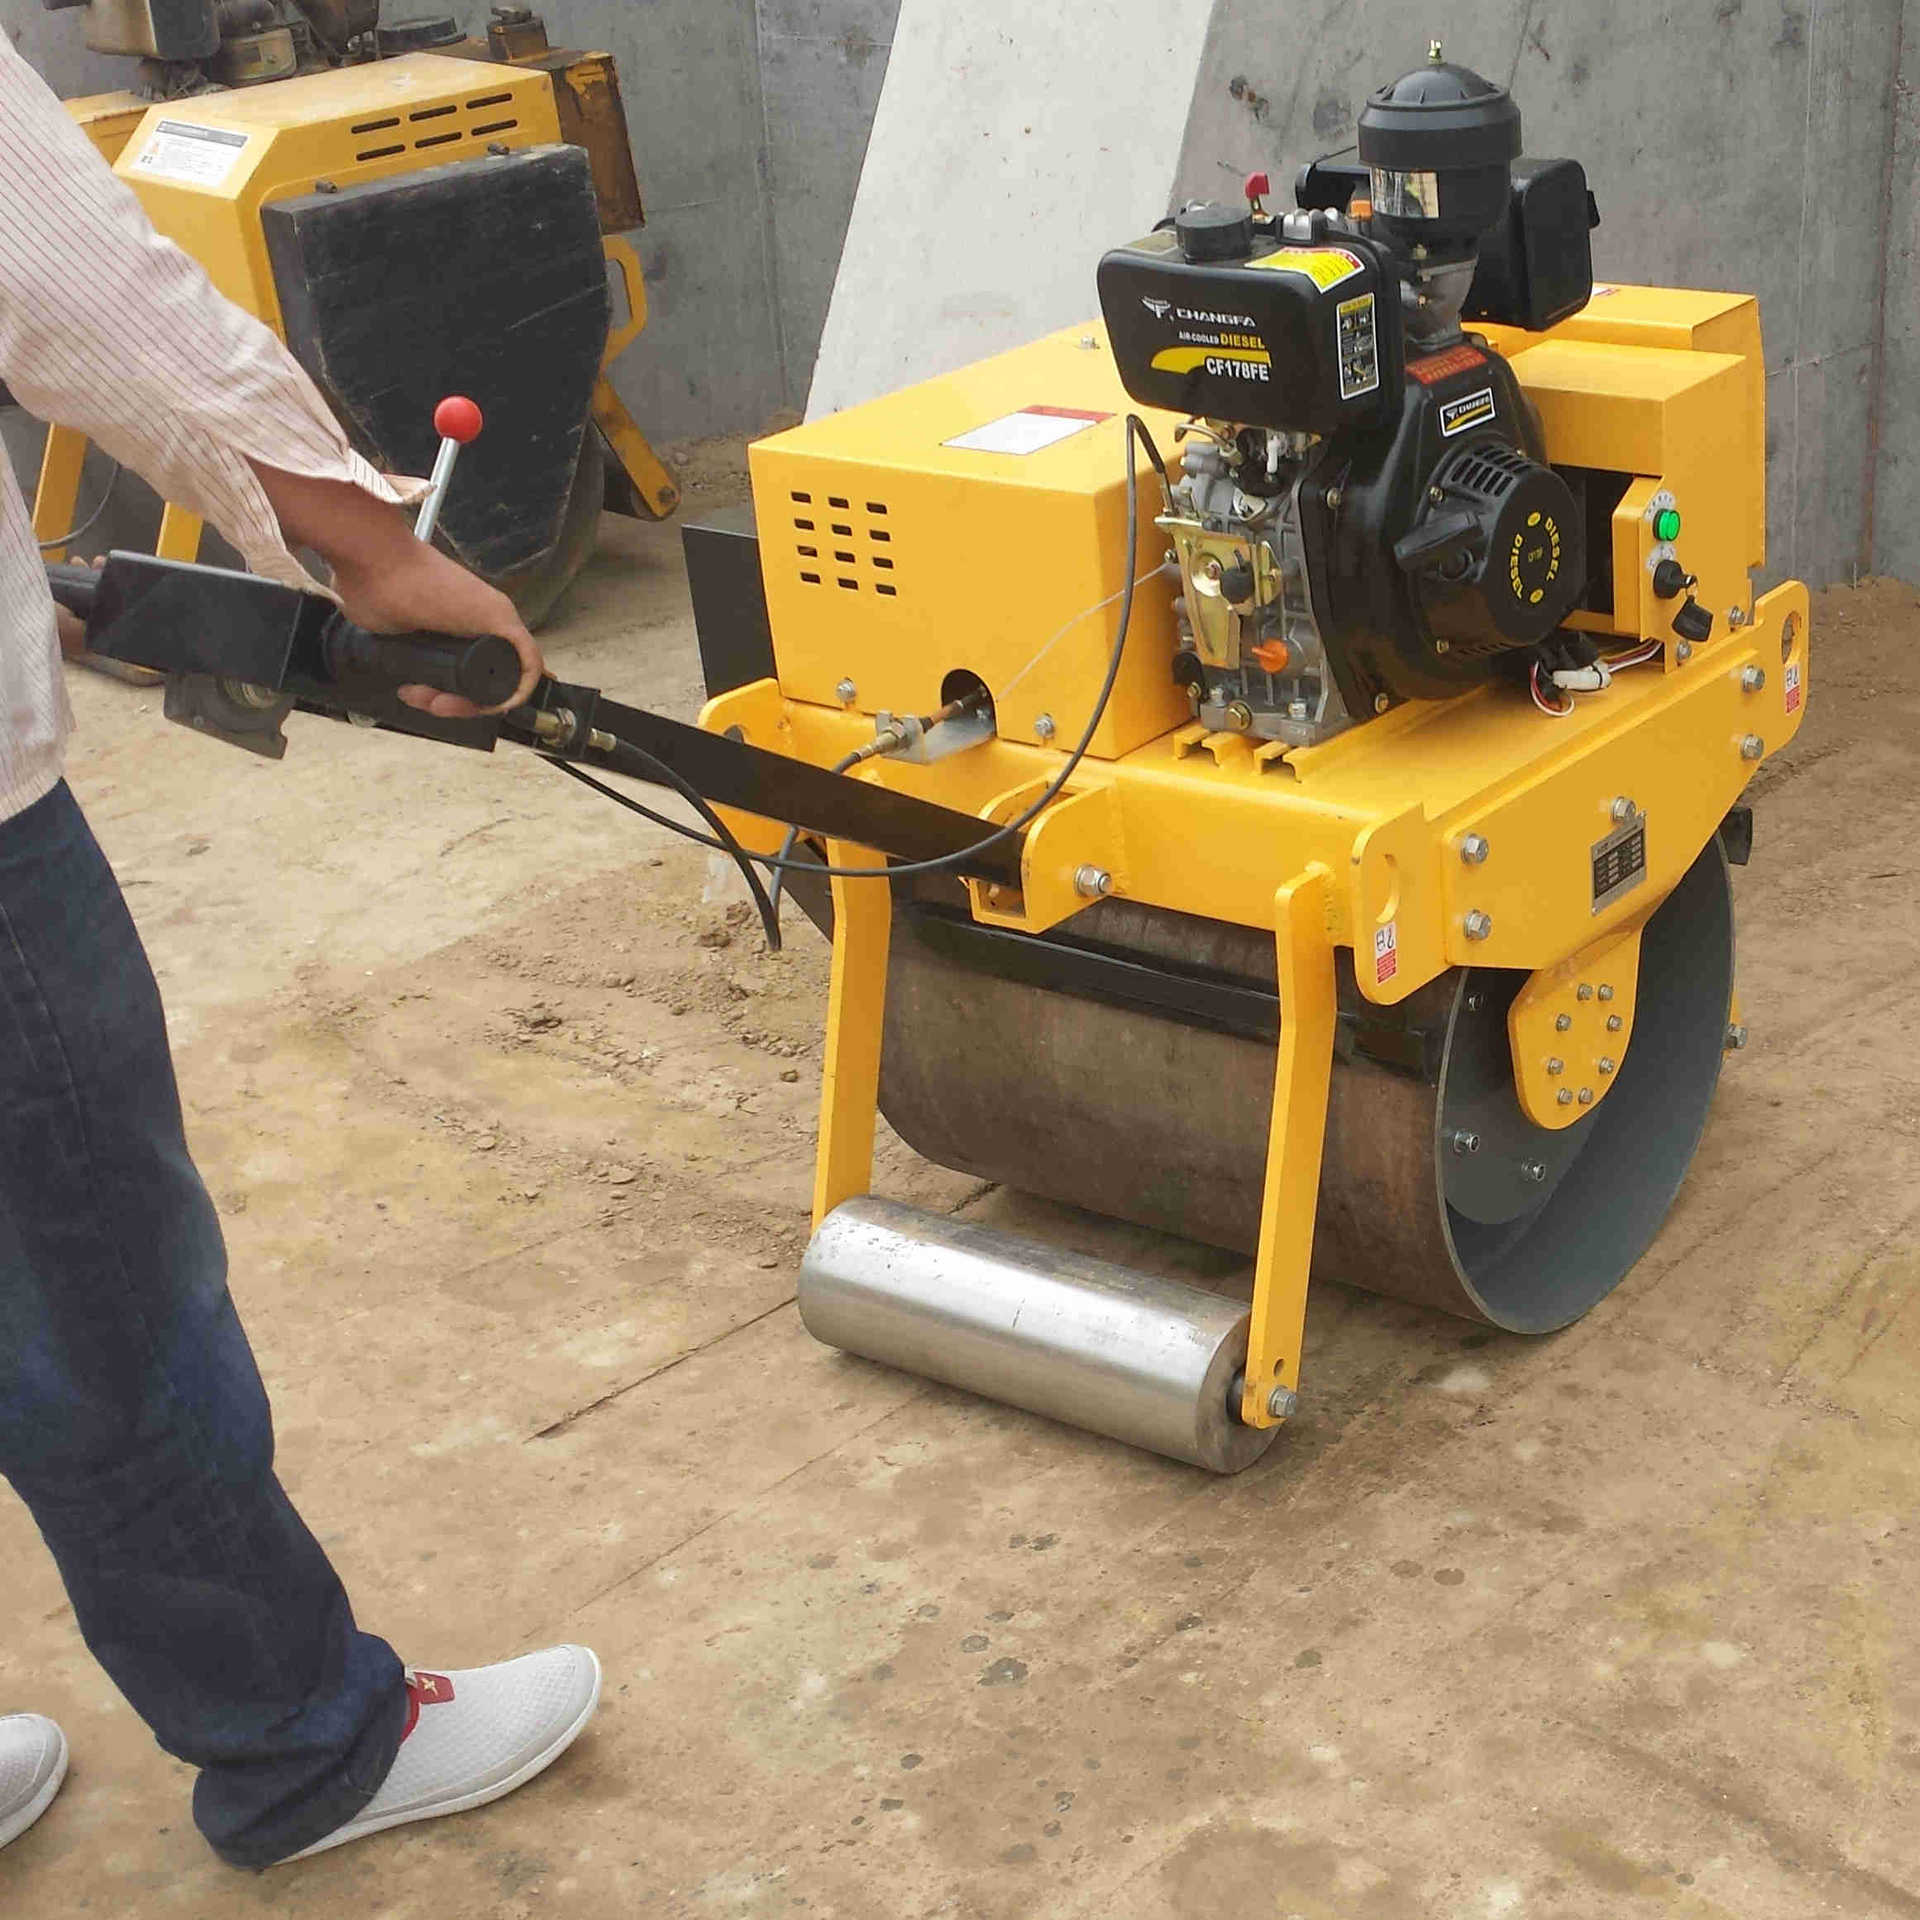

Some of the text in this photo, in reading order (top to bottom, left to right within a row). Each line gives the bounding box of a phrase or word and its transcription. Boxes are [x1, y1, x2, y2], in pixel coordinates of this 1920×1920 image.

[1220, 333, 1265, 349] DIESEL
[1206, 358, 1269, 381] CF178FE
[1545, 516, 1560, 581] DIESEL
